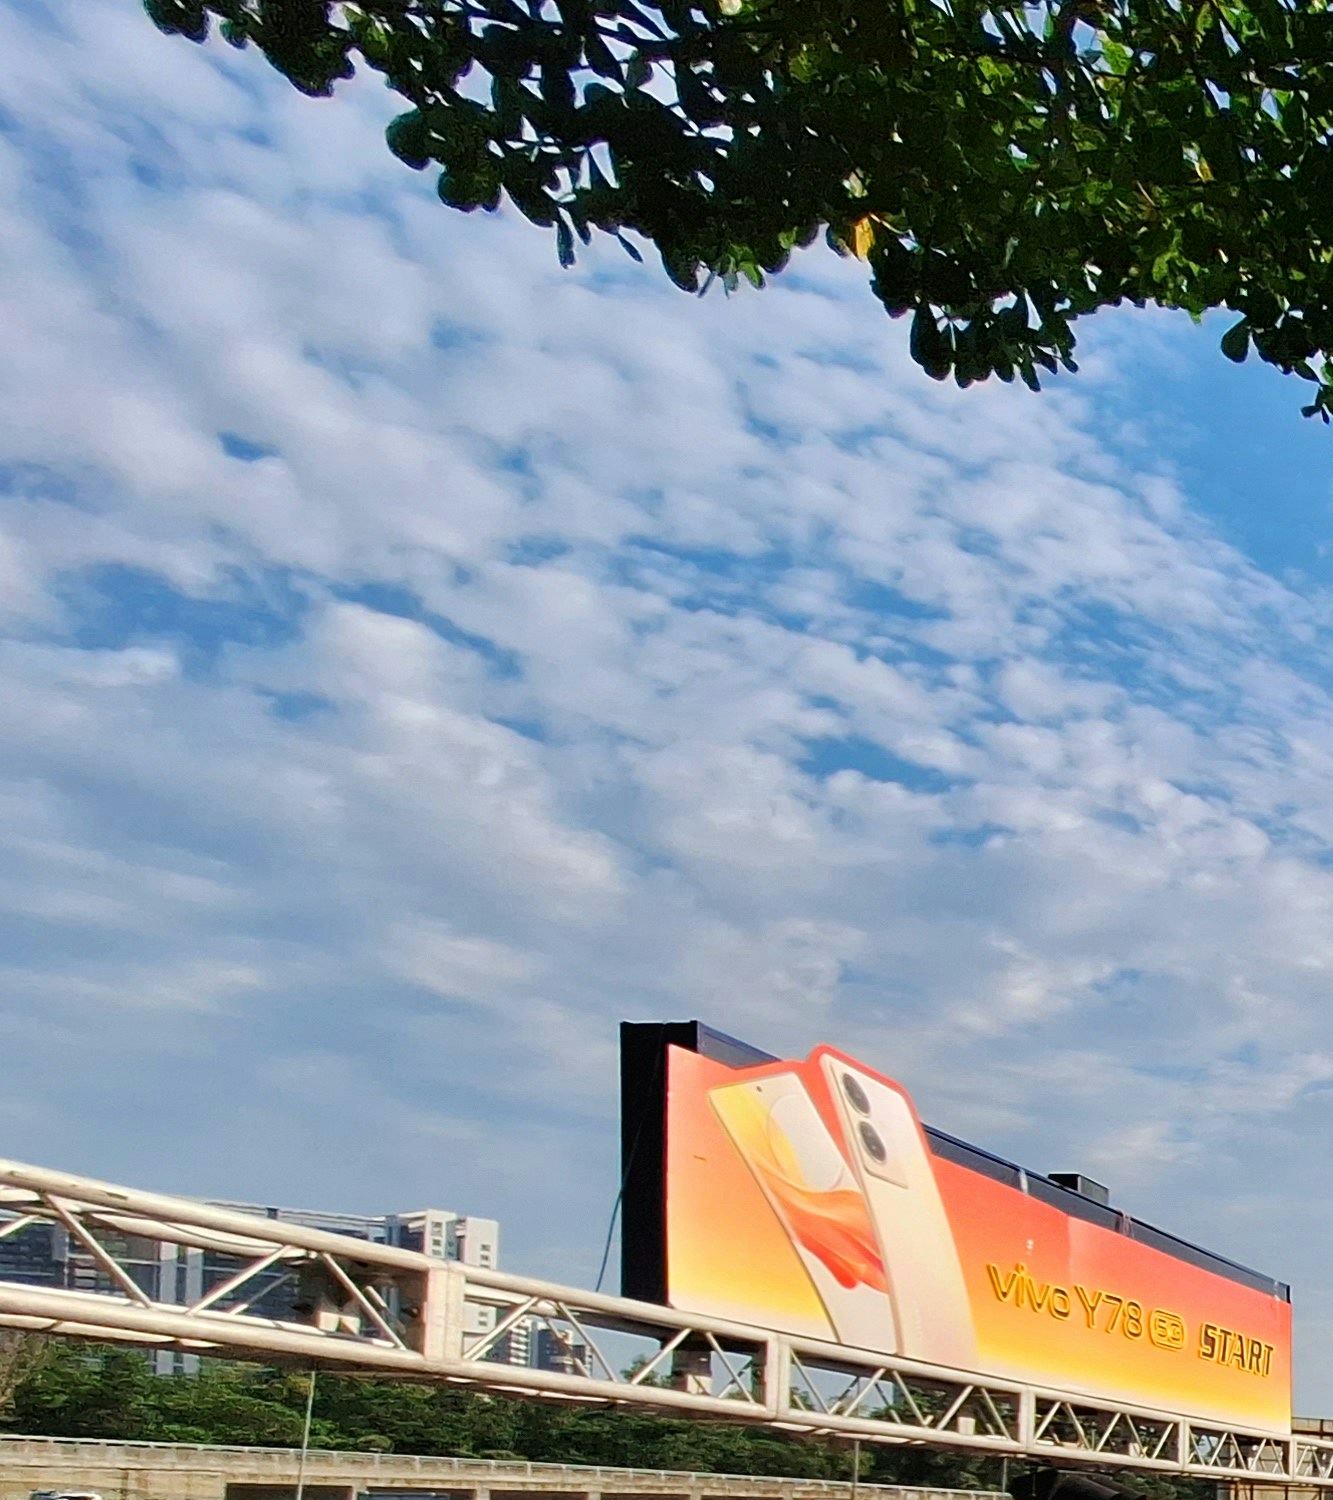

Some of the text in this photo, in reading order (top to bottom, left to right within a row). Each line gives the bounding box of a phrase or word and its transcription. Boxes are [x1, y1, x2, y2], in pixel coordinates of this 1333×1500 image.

[987, 1262, 1071, 1321] vivo
[1074, 1285, 1144, 1340] Y78
[1199, 1322, 1275, 1377] START
